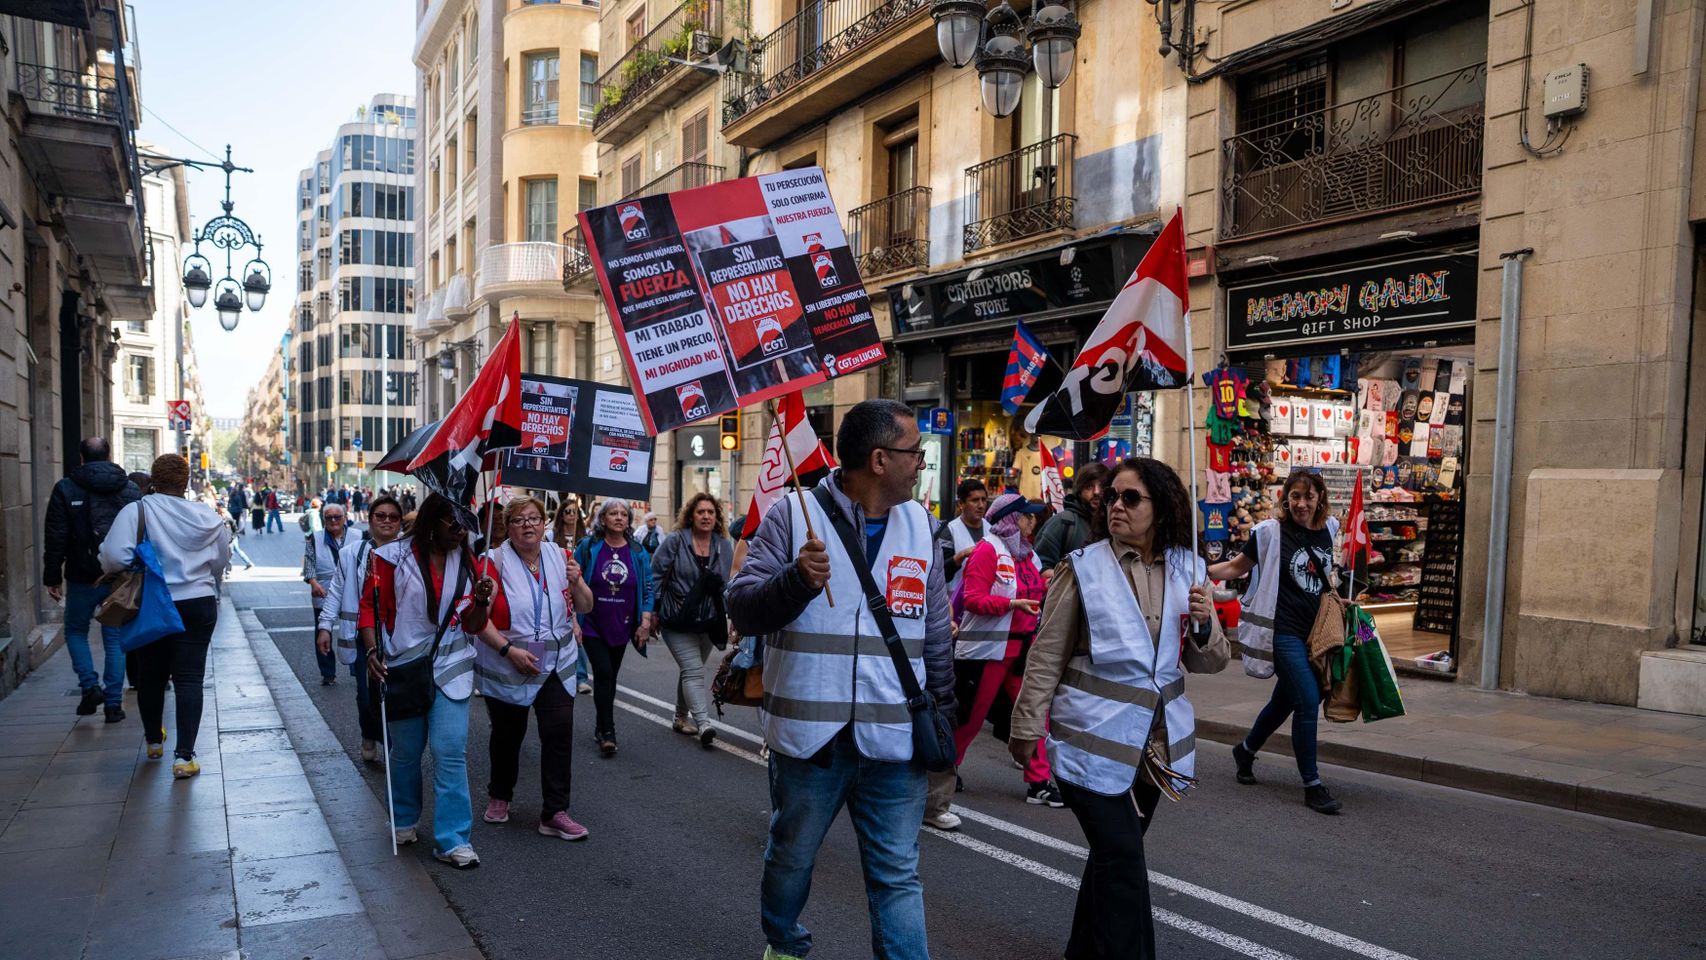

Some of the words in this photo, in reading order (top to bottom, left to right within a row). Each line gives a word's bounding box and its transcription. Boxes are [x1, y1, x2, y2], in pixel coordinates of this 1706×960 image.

[765, 182, 776, 192] TU
[777, 173, 823, 190] PERSECUCIÓN
[771, 197, 789, 208] SOLO
[790, 191, 826, 205] CONFIRMA
[776, 211, 807, 225] NUESTRA
[807, 206, 834, 218] FUERZA.
[627, 227, 647, 240] CGT
[608, 260, 619, 269] NO
[619, 254, 644, 267] SOMOS
[643, 251, 654, 260] UN
[654, 244, 685, 258] NÚMERO,
[732, 245, 755, 262] SIN
[623, 264, 660, 282] SOMOS
[661, 260, 675, 272] LA
[710, 256, 783, 284] REPRESENTANTES
[619, 270, 690, 302] FUERZA
[726, 281, 750, 303] NO
[750, 274, 778, 296] HAY
[821, 275, 837, 286] CGT
[622, 303, 636, 314] QUE
[636, 299, 655, 310] MUEVE
[655, 296, 669, 305] ESTA
[669, 289, 697, 302] EMPRESA.
[724, 290, 794, 324] DERECHOS
[805, 304, 817, 314] SIN
[816, 296, 842, 310] LIBERTAD
[973, 298, 1010, 316] STORE
[1247, 284, 1350, 326] MEMORY
[1359, 270, 1450, 312] GAUDI
[824, 308, 838, 320] NO
[839, 303, 857, 317] HAY
[634, 328, 651, 344] MI
[652, 314, 703, 338] TRABAJO
[813, 319, 850, 336] DEMOCRACIA
[1302, 320, 1335, 336] GIFT
[1343, 315, 1381, 330] SHOP
[636, 346, 664, 363] TIENE
[665, 341, 679, 355] UN
[680, 332, 716, 350] PRECIO,
[763, 338, 784, 352] CGT
[645, 368, 657, 380] MI
[659, 354, 702, 376] DIGNIDAD
[704, 349, 720, 362] NO.
[838, 357, 852, 370] CGT
[858, 347, 882, 363] LUCHA
[540, 396, 553, 405] SIN
[1220, 385, 1235, 403] 10
[522, 403, 569, 415] REPRESENTANTES
[686, 405, 707, 419] CGT
[521, 421, 565, 436] DERECHOS
[527, 413, 541, 423] NO
[541, 414, 560, 426] HAY
[610, 463, 627, 471] CGT
[891, 601, 923, 616] CGT
